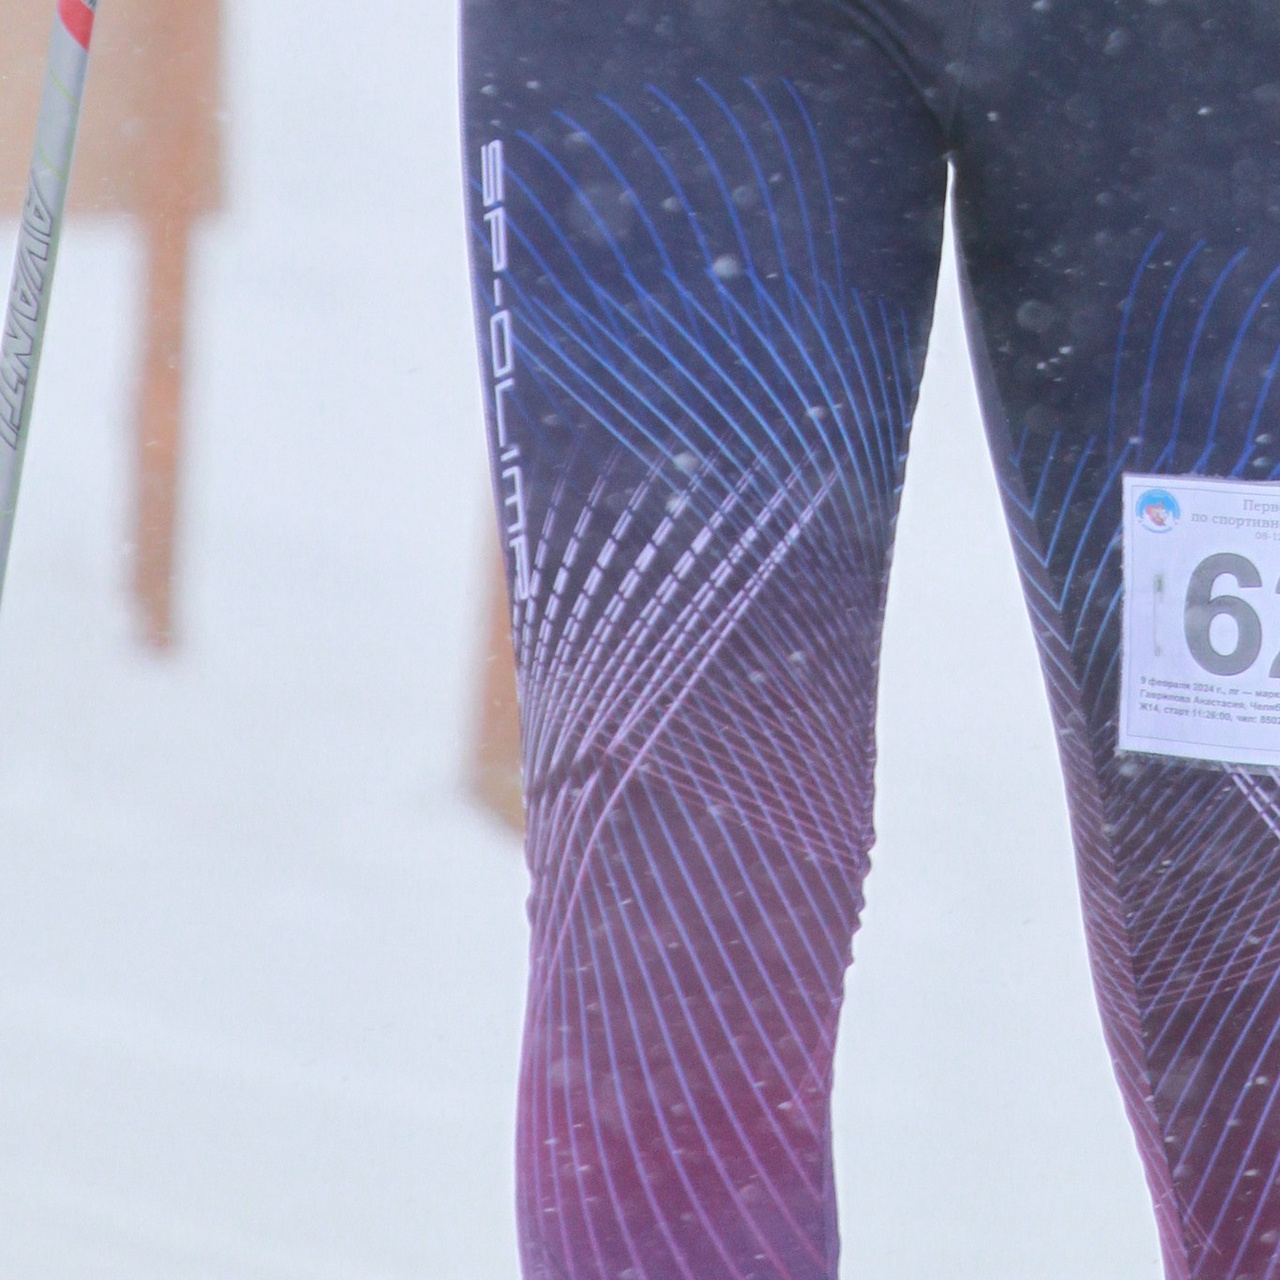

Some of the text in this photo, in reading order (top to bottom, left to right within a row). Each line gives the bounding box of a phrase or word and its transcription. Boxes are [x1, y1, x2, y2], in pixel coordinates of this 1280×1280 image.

[1190, 513, 1209, 523] по
[1140, 676, 1147, 685] 9
[1192, 683, 1214, 693] 2024
[1139, 688, 1191, 703] Гаврилова
[1194, 696, 1246, 710] Анастасия,
[1163, 706, 1189, 717] старт
